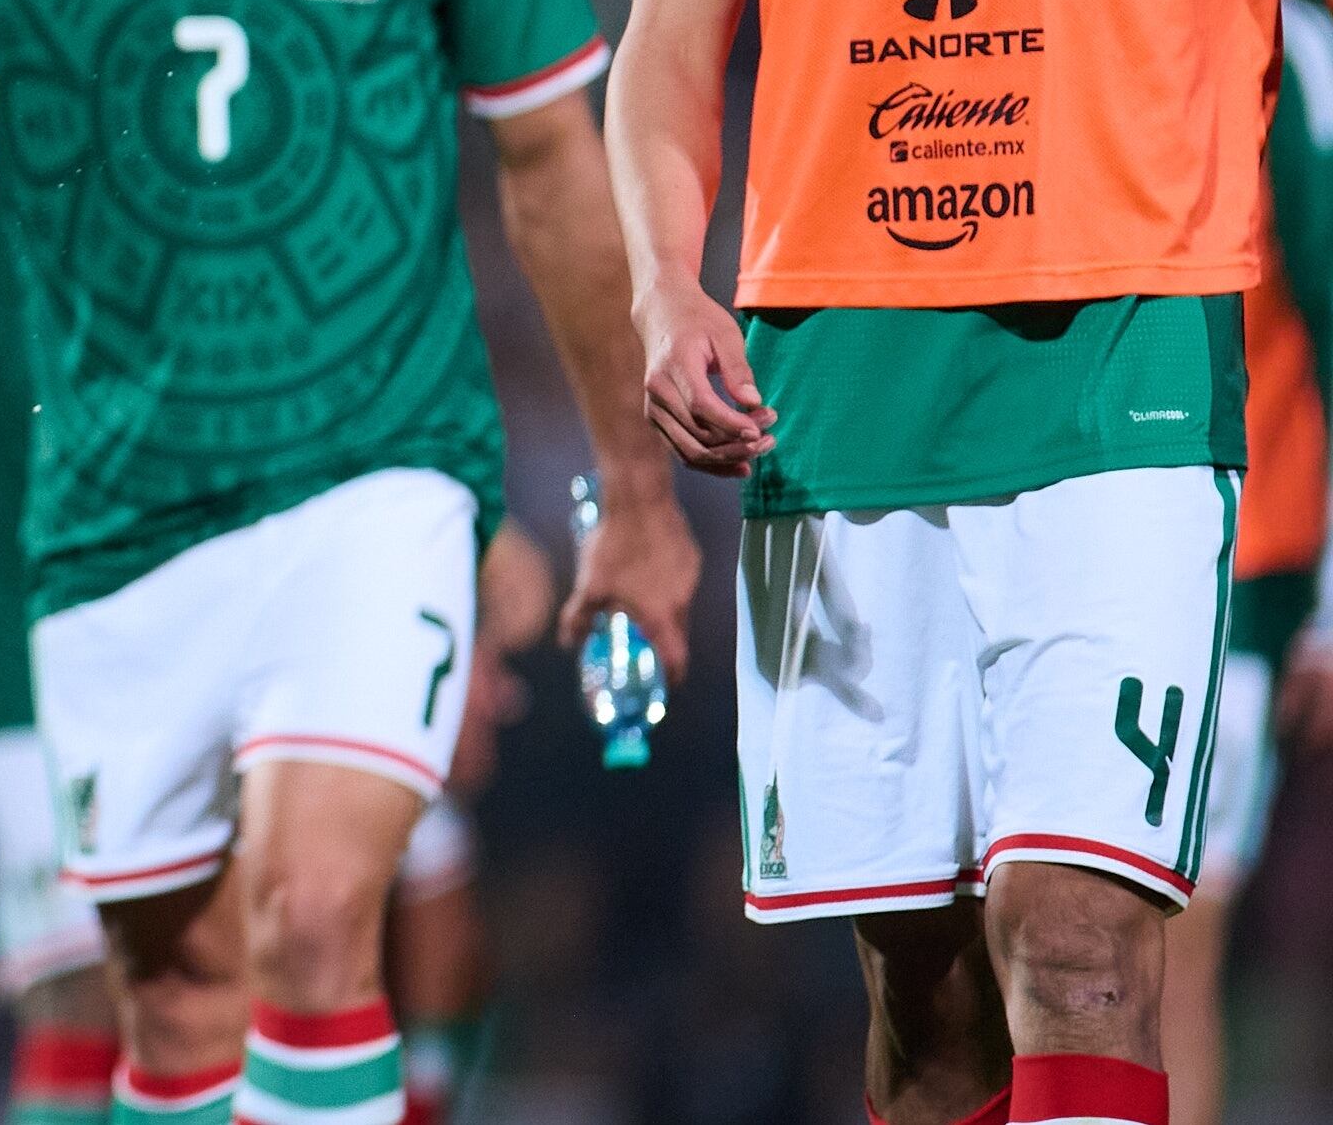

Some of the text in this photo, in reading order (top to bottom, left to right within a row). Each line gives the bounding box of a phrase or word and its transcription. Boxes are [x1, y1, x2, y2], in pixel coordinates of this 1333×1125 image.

[849, 28, 1044, 64] BANORTE
[174, 16, 249, 162] 7
[866, 82, 1031, 140] Caliente
[911, 139, 1025, 160] caliente.mx
[867, 180, 1035, 223] amazon
[419, 606, 457, 728] 7
[1114, 676, 1185, 828] 4
